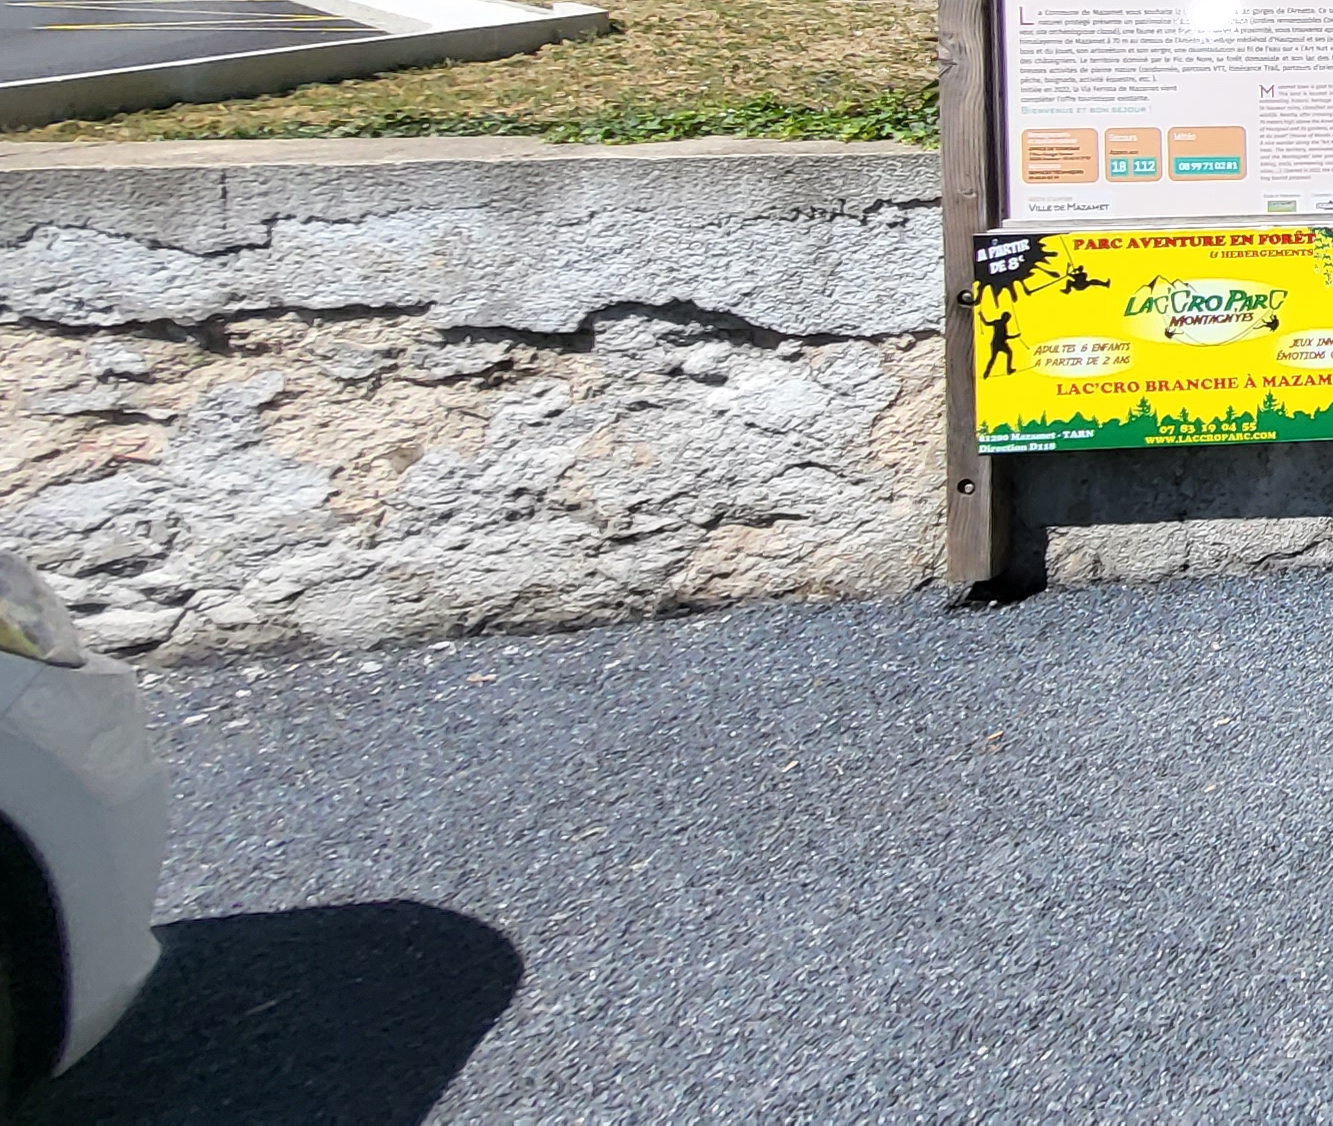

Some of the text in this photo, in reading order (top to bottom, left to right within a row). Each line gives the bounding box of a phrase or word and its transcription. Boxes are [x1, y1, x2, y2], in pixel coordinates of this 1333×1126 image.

[1111, 160, 1155, 173] 18 112
[1073, 231, 1316, 250] PARC AVENTURE EN FORÊT
[976, 239, 1031, 262] A PARTIR
[1221, 249, 1313, 259] HEBERGEMENTS
[989, 259, 1007, 274] DE
[1033, 344, 1076, 356] ADULTES
[1091, 342, 1131, 352] ENFANTS
[1289, 337, 1314, 348] JEUX
[1034, 355, 1130, 367] A PARTIR DE 2 ANS
[1056, 382, 1140, 396] LAC'CRO
[1145, 377, 1239, 392] BRANCHE
[1243, 374, 1258, 389] À
[1159, 425, 1175, 435] 07
[1201, 423, 1216, 433] 19
[1221, 423, 1236, 432] 04
[1242, 422, 1257, 431] 55
[1010, 432, 1056, 441] Mazamet
[1063, 430, 1095, 439] TARN
[1145, 431, 1276, 444] WWW.LACCROPARC.COM
[978, 443, 1027, 453] Direction
